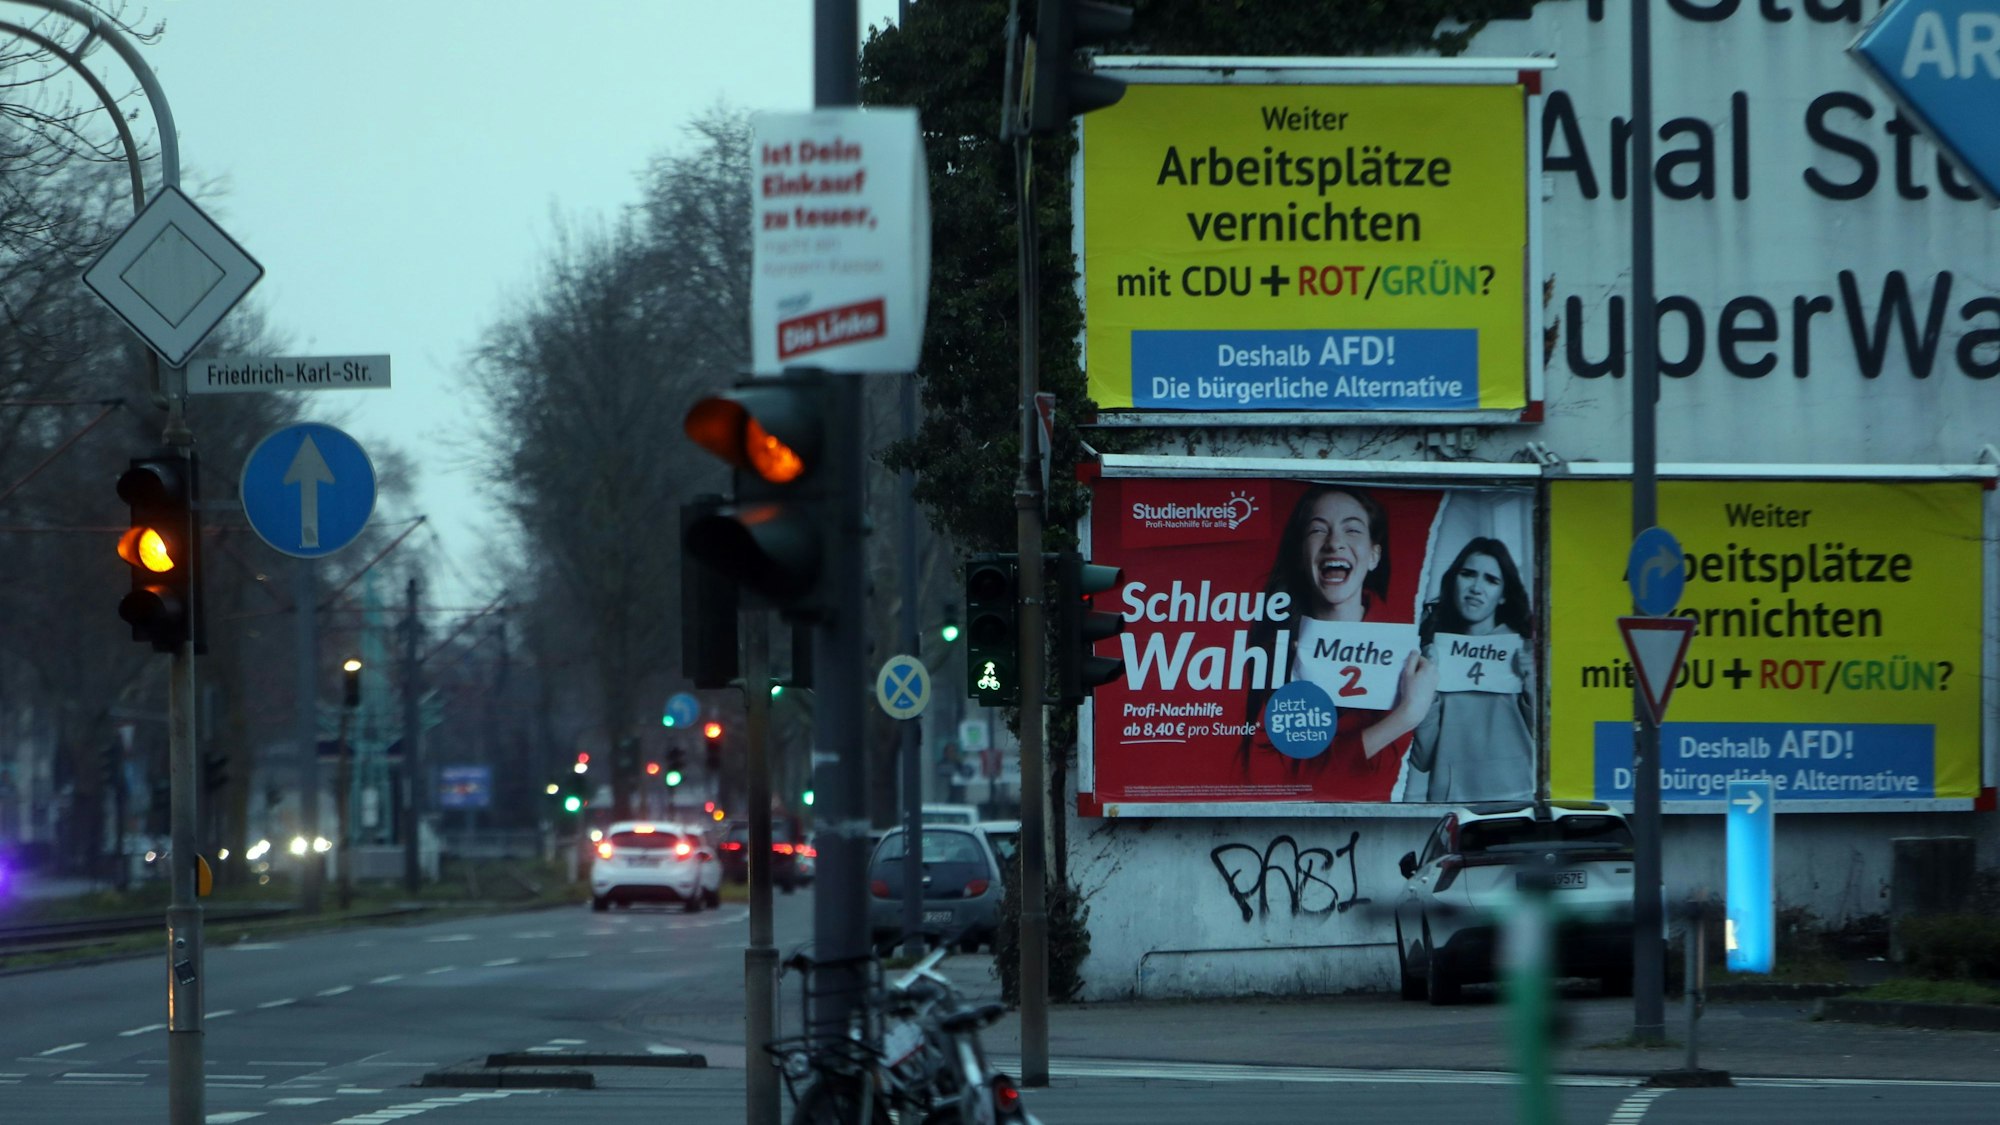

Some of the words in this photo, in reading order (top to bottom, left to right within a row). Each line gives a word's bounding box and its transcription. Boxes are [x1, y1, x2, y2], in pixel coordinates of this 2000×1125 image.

[1261, 106, 1348, 131] Weiter
[798, 136, 862, 164] Dein
[1542, 91, 1748, 200] Aral
[1804, 91, 1982, 200] St
[1157, 146, 1452, 196] Arbeitsplätze
[1187, 202, 1421, 241] vernichten
[1117, 267, 1171, 297] mit
[1181, 265, 1251, 297] CDU
[1260, 265, 1290, 297] +
[1218, 343, 1311, 368] Deshalb
[1319, 336, 1396, 366] AFD!
[207, 361, 372, 386] Friedrich-Karl-Str.
[1152, 377, 1190, 400] Die
[1198, 377, 1329, 403] bürgerliche
[1334, 377, 1462, 399] Alternative
[1133, 502, 1237, 519] Studienkreis
[1725, 504, 1811, 529] Weiter
[1146, 521, 1200, 529] Profi-Nachhilfe
[1202, 520, 1212, 528] für
[1214, 520, 1227, 528] alle
[1120, 580, 1291, 623] Schlaue
[1665, 598, 1882, 638] ernichten
[1120, 630, 1290, 690] Wahl
[1313, 637, 1393, 666] Mathe
[1450, 639, 1508, 662] Mathe
[1338, 665, 1368, 698] 2
[1467, 662, 1485, 686] 4
[1581, 658, 1635, 688] mit
[1722, 658, 1752, 690] +
[1123, 703, 1223, 718] Profi-Nachhilfe
[1272, 699, 1306, 712] Jetzt
[1123, 722, 1140, 736] ab
[1143, 722, 1174, 739] 8,40
[1176, 722, 1186, 736] €
[1188, 725, 1209, 738] pro
[1272, 707, 1332, 733] gratis
[1286, 728, 1327, 742] testen
[1680, 736, 1770, 758] Deshalb
[1779, 730, 1853, 759] AFD!
[1793, 770, 1919, 791] Alternative
